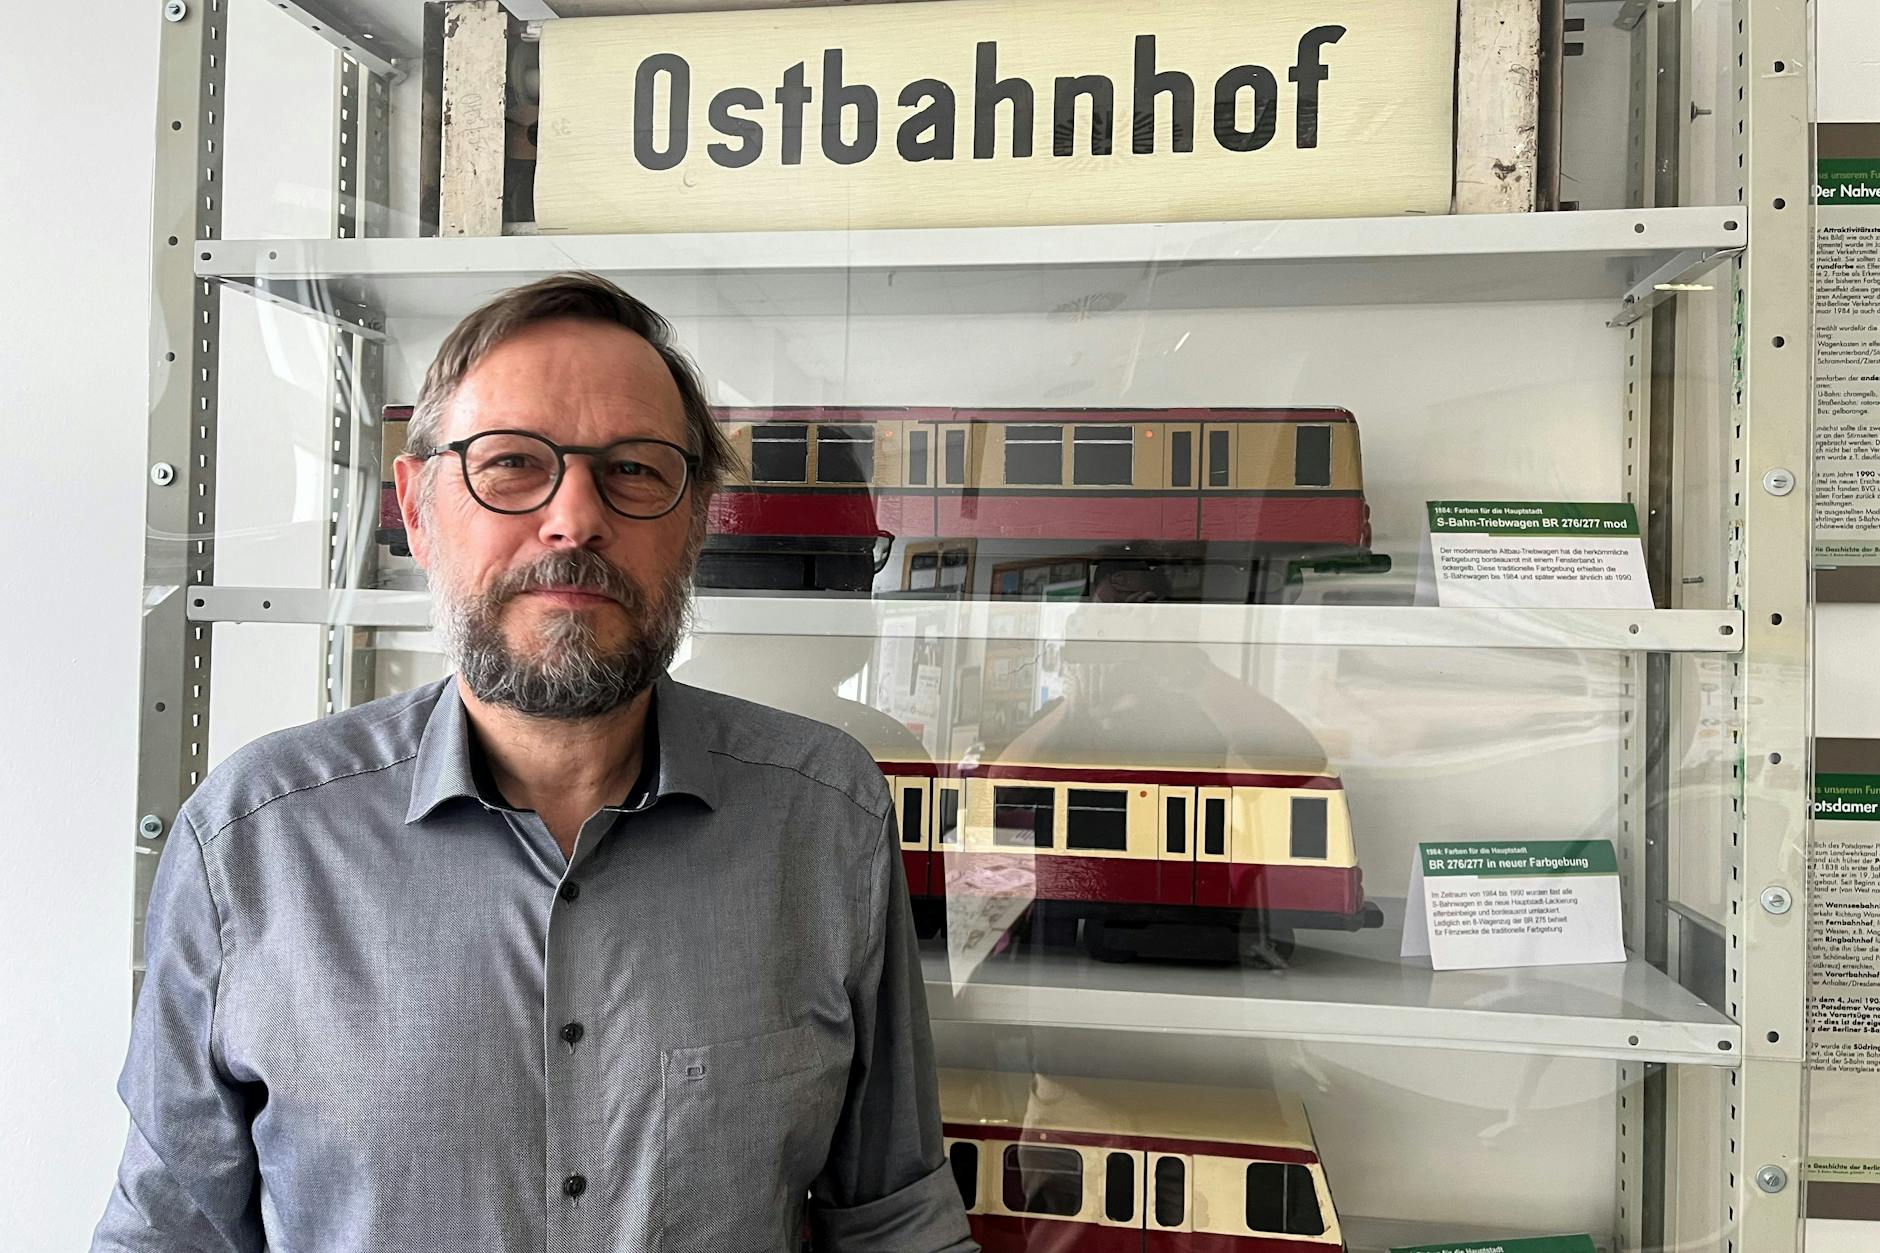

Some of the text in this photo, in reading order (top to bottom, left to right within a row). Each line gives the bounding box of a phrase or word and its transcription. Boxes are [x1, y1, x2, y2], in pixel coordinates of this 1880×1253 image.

[633, 25, 1347, 170] Ostbahnhof
[1812, 183, 1836, 197] Der
[1437, 517, 1628, 529] S-Bahn-Triebwagen BR 276/277 mod
[1814, 797, 1878, 813] otsdamer
[1491, 847, 1528, 855] Hauptstadt
[1429, 857, 1589, 870] BR 276/277 in neuer Farbgebung
